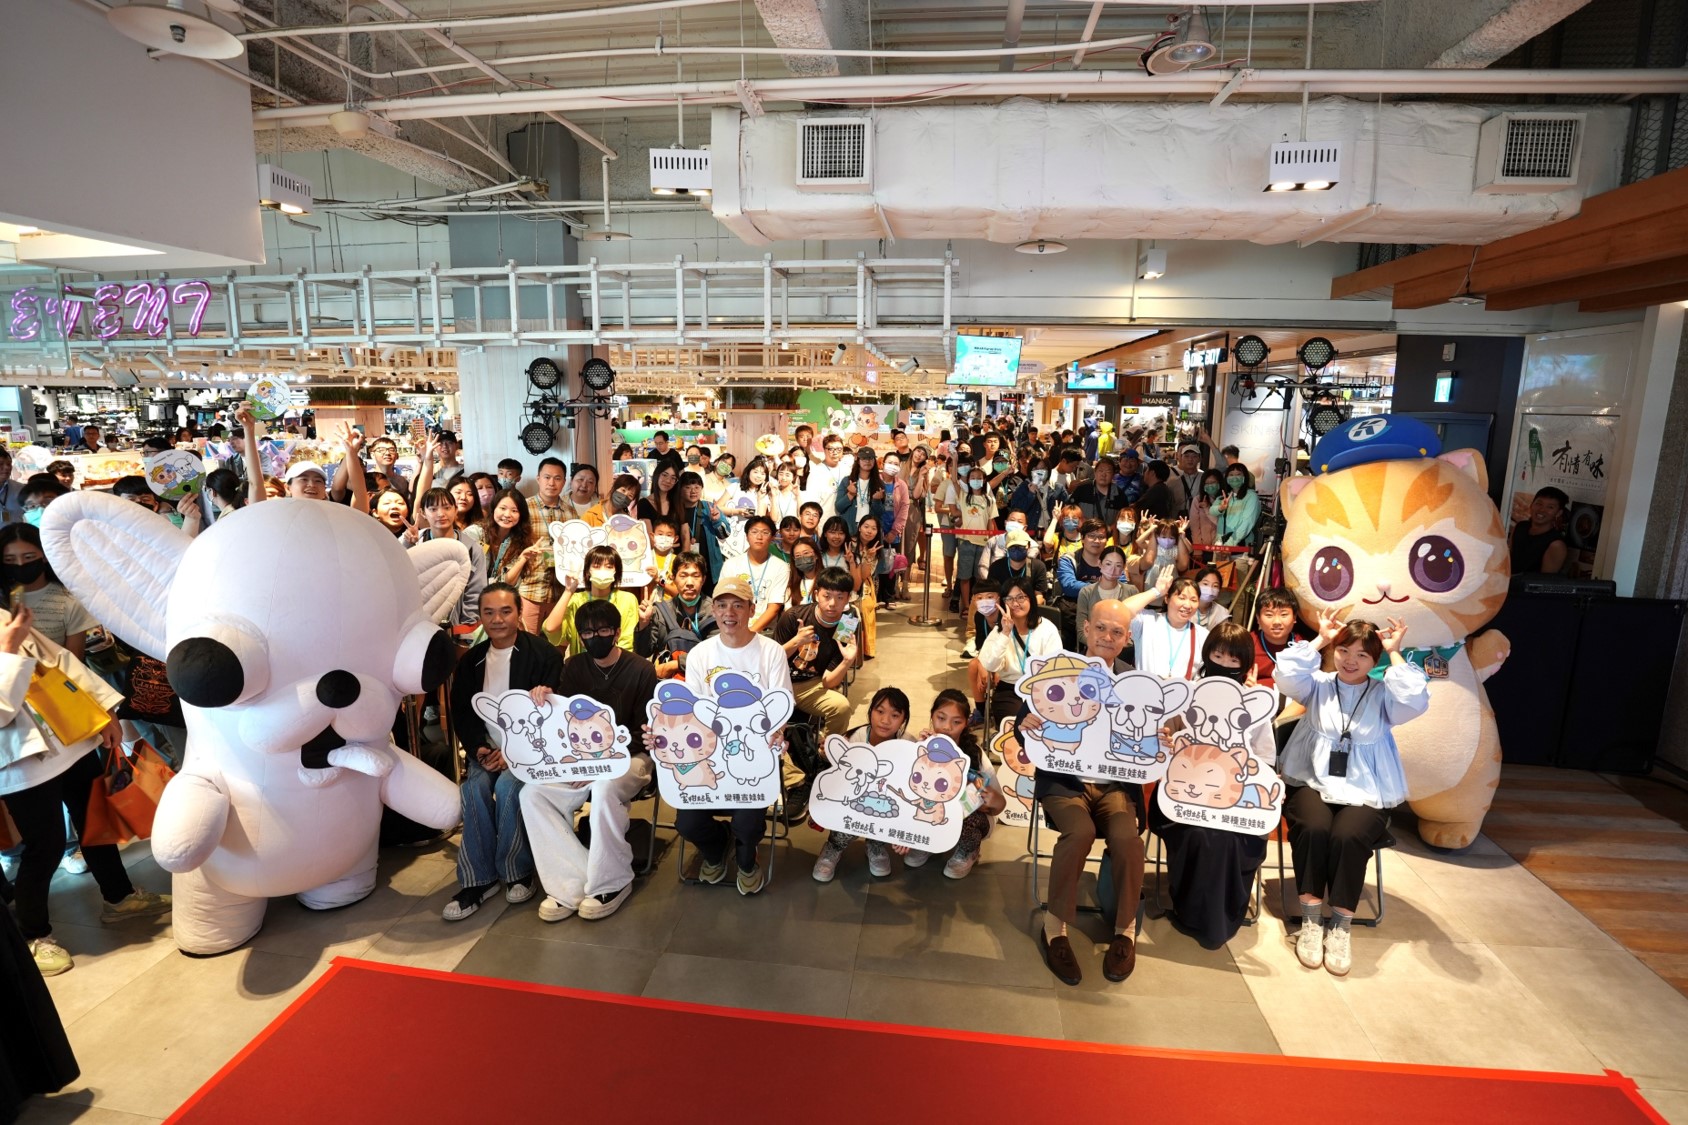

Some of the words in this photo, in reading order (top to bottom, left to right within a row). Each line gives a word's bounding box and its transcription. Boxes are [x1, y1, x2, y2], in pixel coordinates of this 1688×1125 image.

[10, 281, 212, 339] EVENT
[1230, 424, 1263, 436] SKIN
[1552, 440, 1604, 480] 有情有味
[526, 767, 562, 780] 蜜柑站長
[570, 764, 613, 775] 變種吉娃娃
[1045, 754, 1084, 773] 蜜柑站長
[1098, 764, 1147, 780] 變種吉娃娃
[679, 792, 714, 804] 蜜柑站長
[724, 793, 766, 802] 變種吉娃娃
[1174, 804, 1209, 822] 蜜柑站長
[1221, 814, 1266, 829] 變種吉娃娃
[843, 815, 876, 835] 蜜柑站長
[888, 828, 930, 846] 變種吉娃娃
